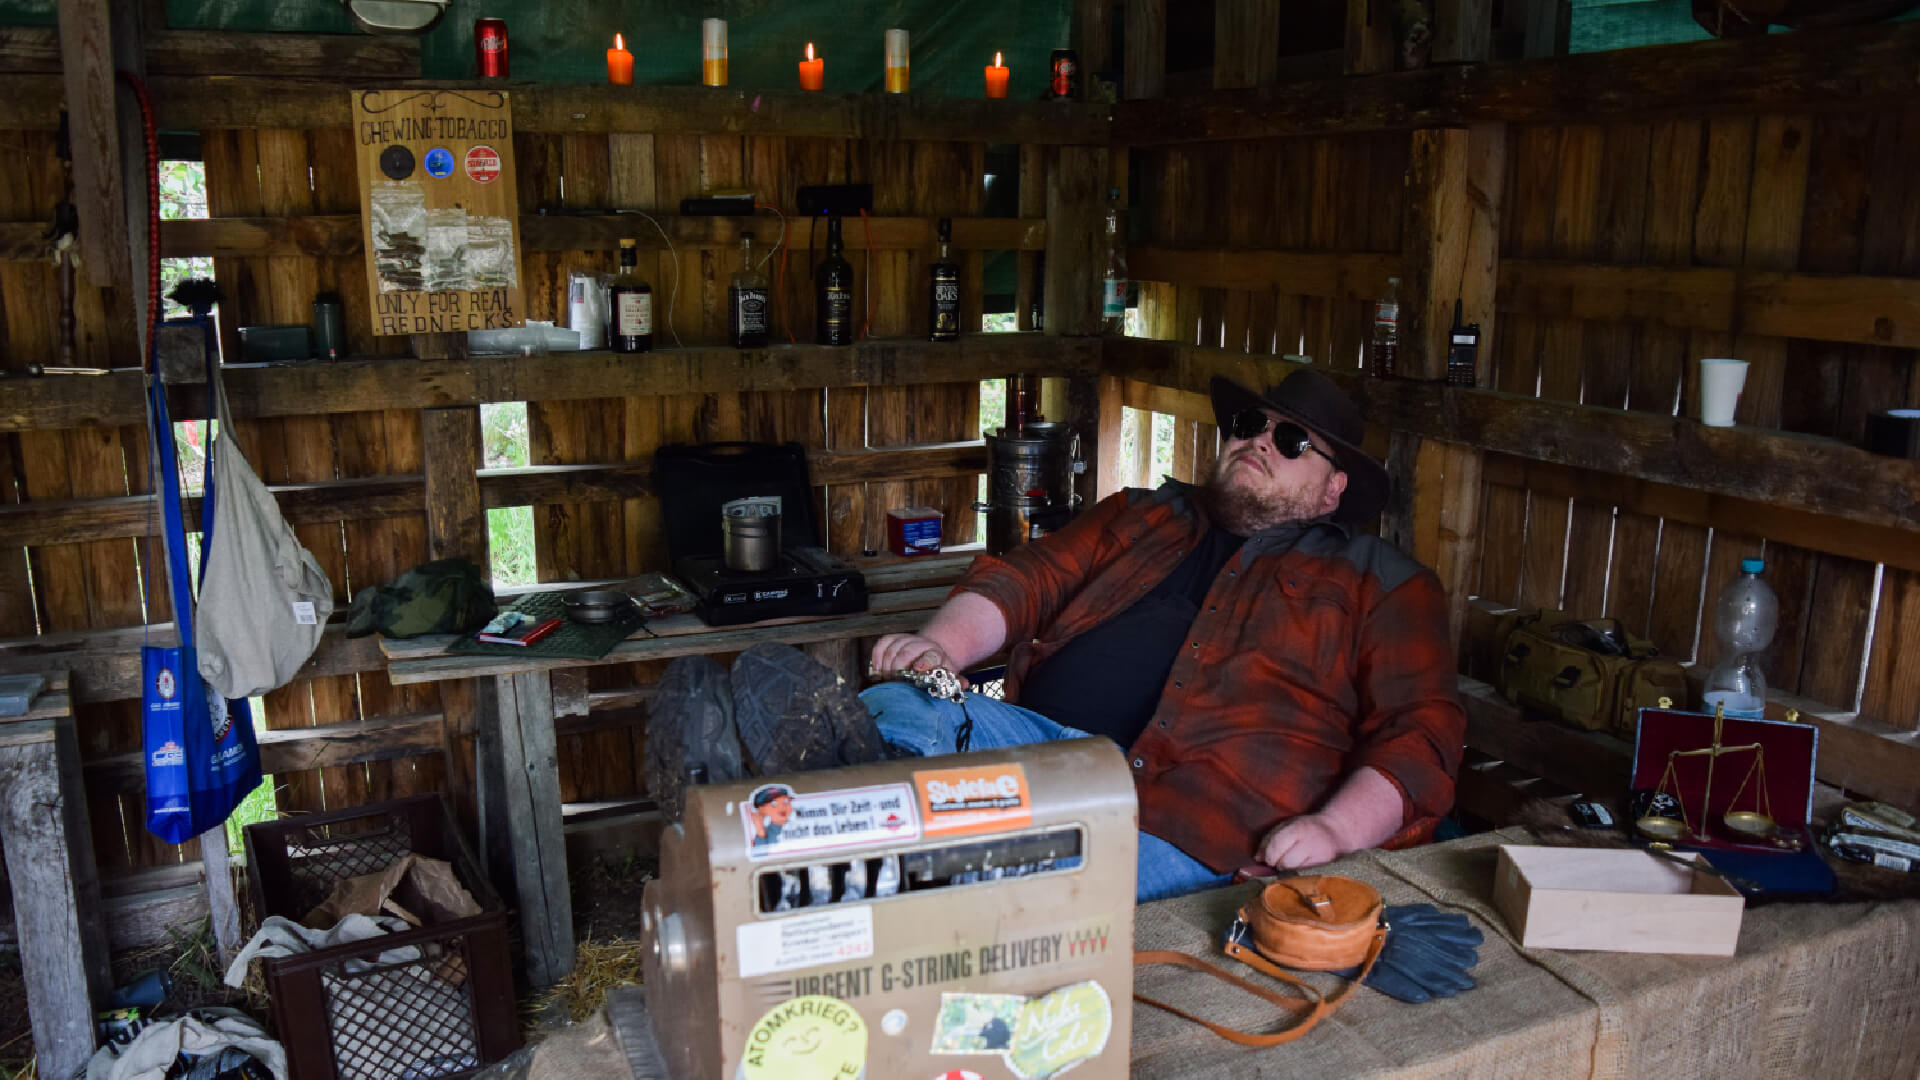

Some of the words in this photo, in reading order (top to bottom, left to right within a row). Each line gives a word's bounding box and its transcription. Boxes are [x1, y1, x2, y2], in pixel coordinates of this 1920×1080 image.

[376, 293, 420, 314] ONLY
[428, 291, 461, 314] FOR
[470, 290, 511, 312] REAL
[850, 800, 871, 814] Zeit
[880, 797, 901, 811] und
[813, 823, 833, 836] das
[795, 967, 873, 999] URGENT
[882, 950, 972, 991] G-STRING
[980, 933, 1063, 975] DELIVERY
[748, 1000, 860, 1067] ATOMKRIEG?
